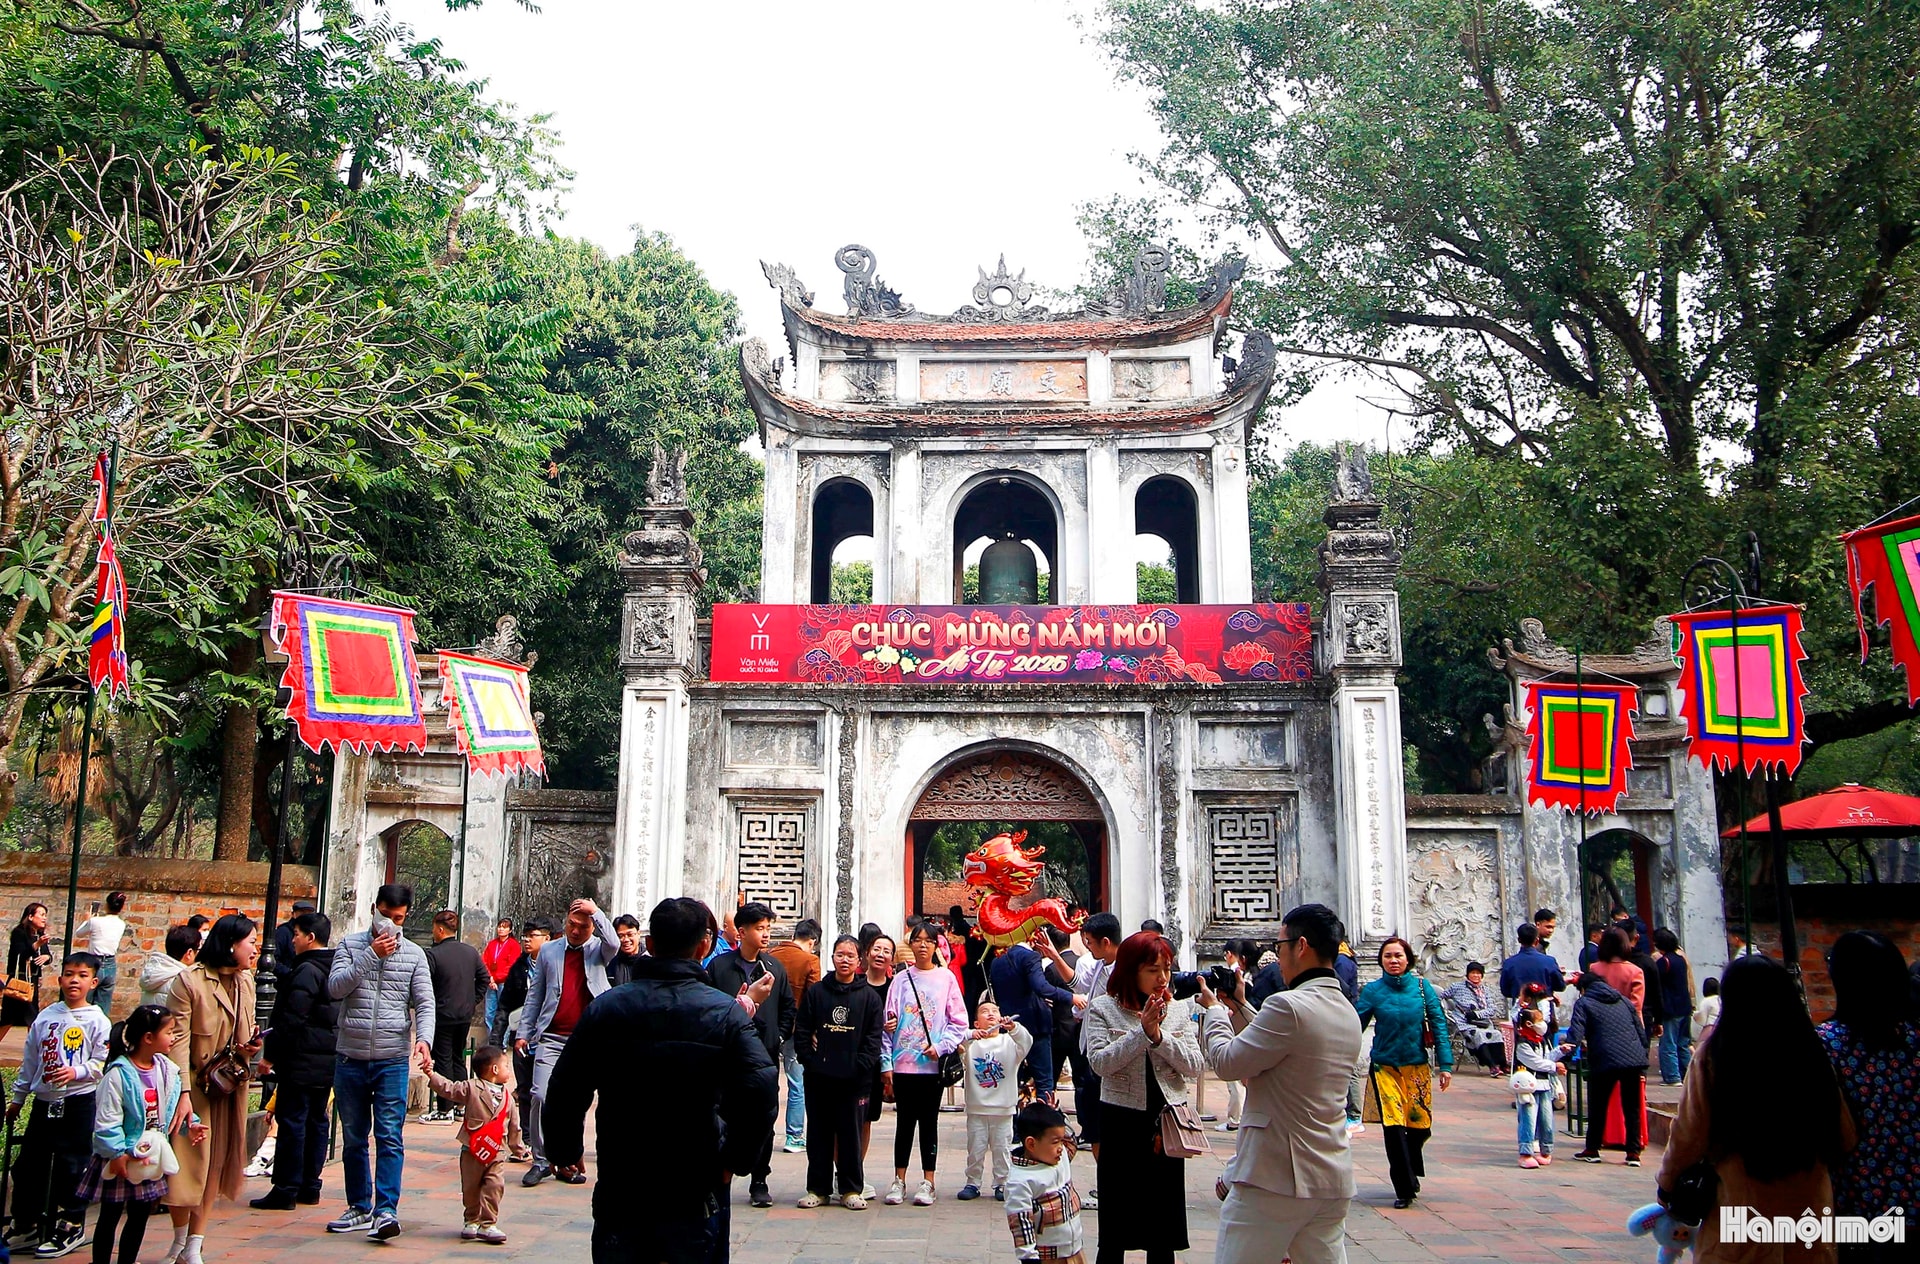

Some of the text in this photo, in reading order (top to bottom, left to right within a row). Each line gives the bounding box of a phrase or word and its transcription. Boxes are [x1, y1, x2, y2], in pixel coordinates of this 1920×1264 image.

[851, 616, 1167, 646] CHÚC MỪNG NĂM MỚI
[739, 657, 779, 667] Văn Miếu
[1010, 655, 1069, 672] 2025
[475, 1146, 491, 1161] 10
